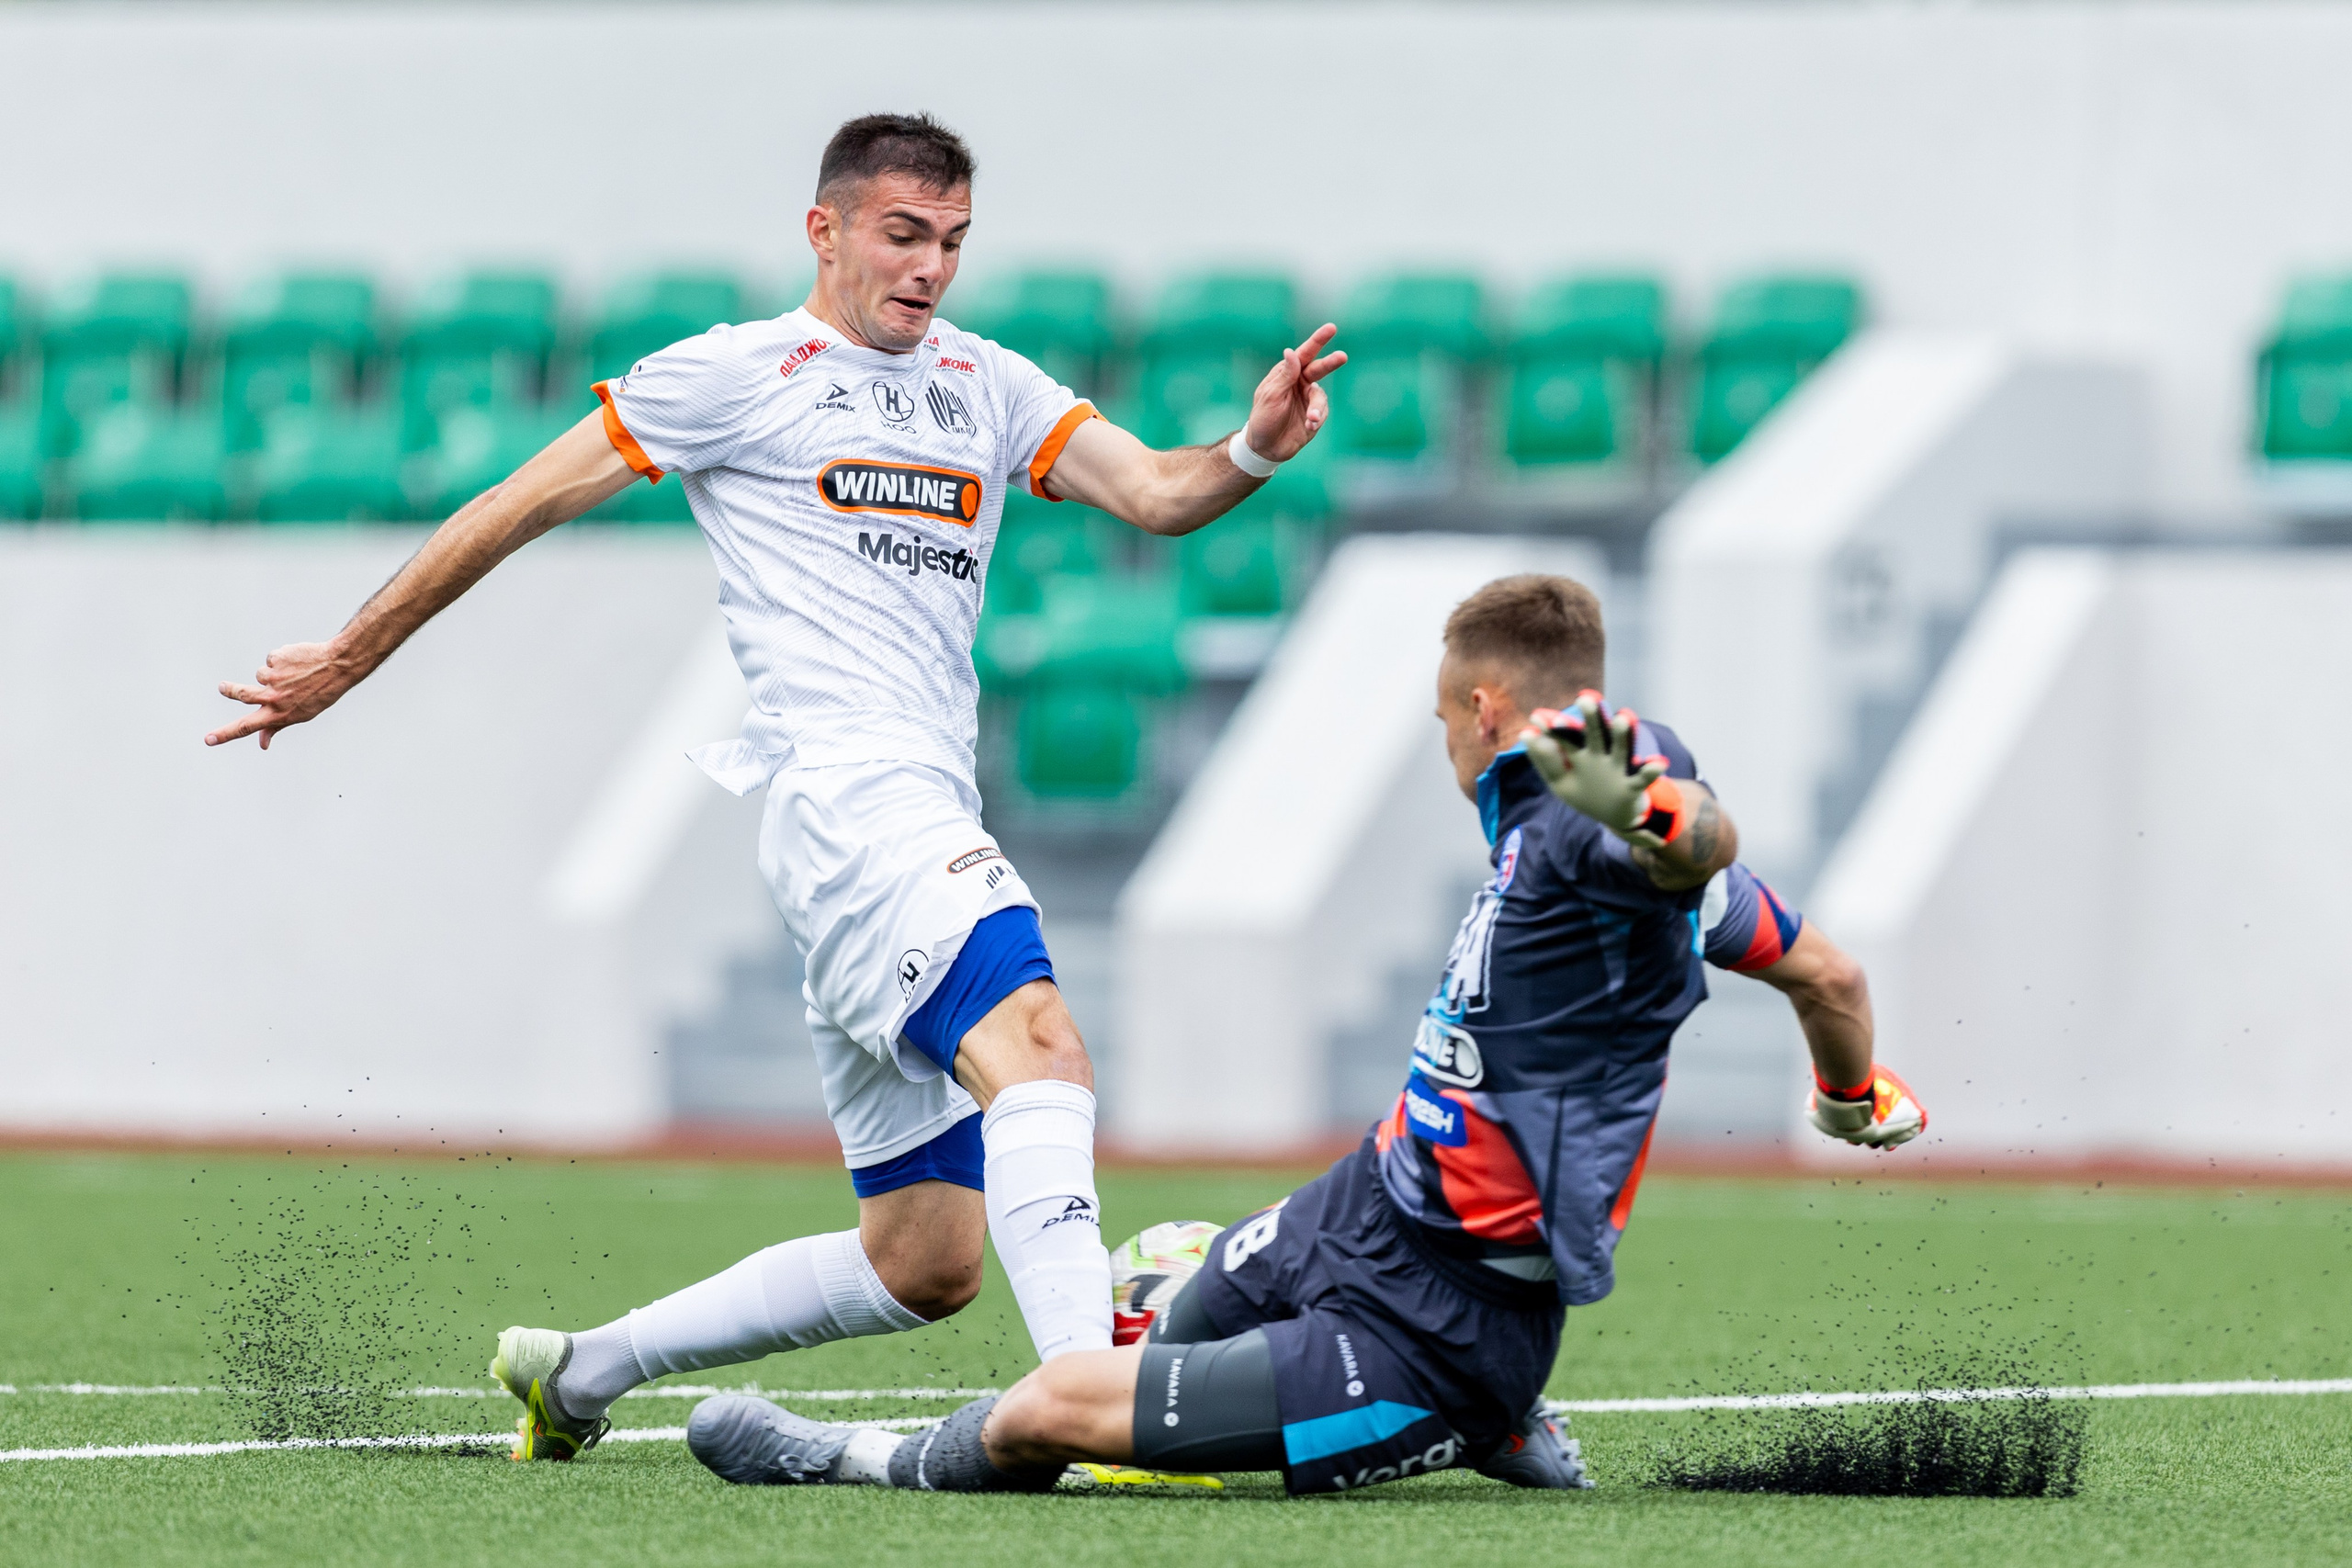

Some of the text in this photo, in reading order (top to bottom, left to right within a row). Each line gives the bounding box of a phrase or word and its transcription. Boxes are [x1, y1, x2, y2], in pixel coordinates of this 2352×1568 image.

[935, 357, 976, 373] ЖОНС
[815, 401, 856, 413] DEMIX
[833, 471, 957, 511] WINLINE
[951, 849, 1001, 872] WINLINE
[1335, 1334, 1360, 1381] KAVARA
[1166, 1358, 1184, 1407] KAVARA
